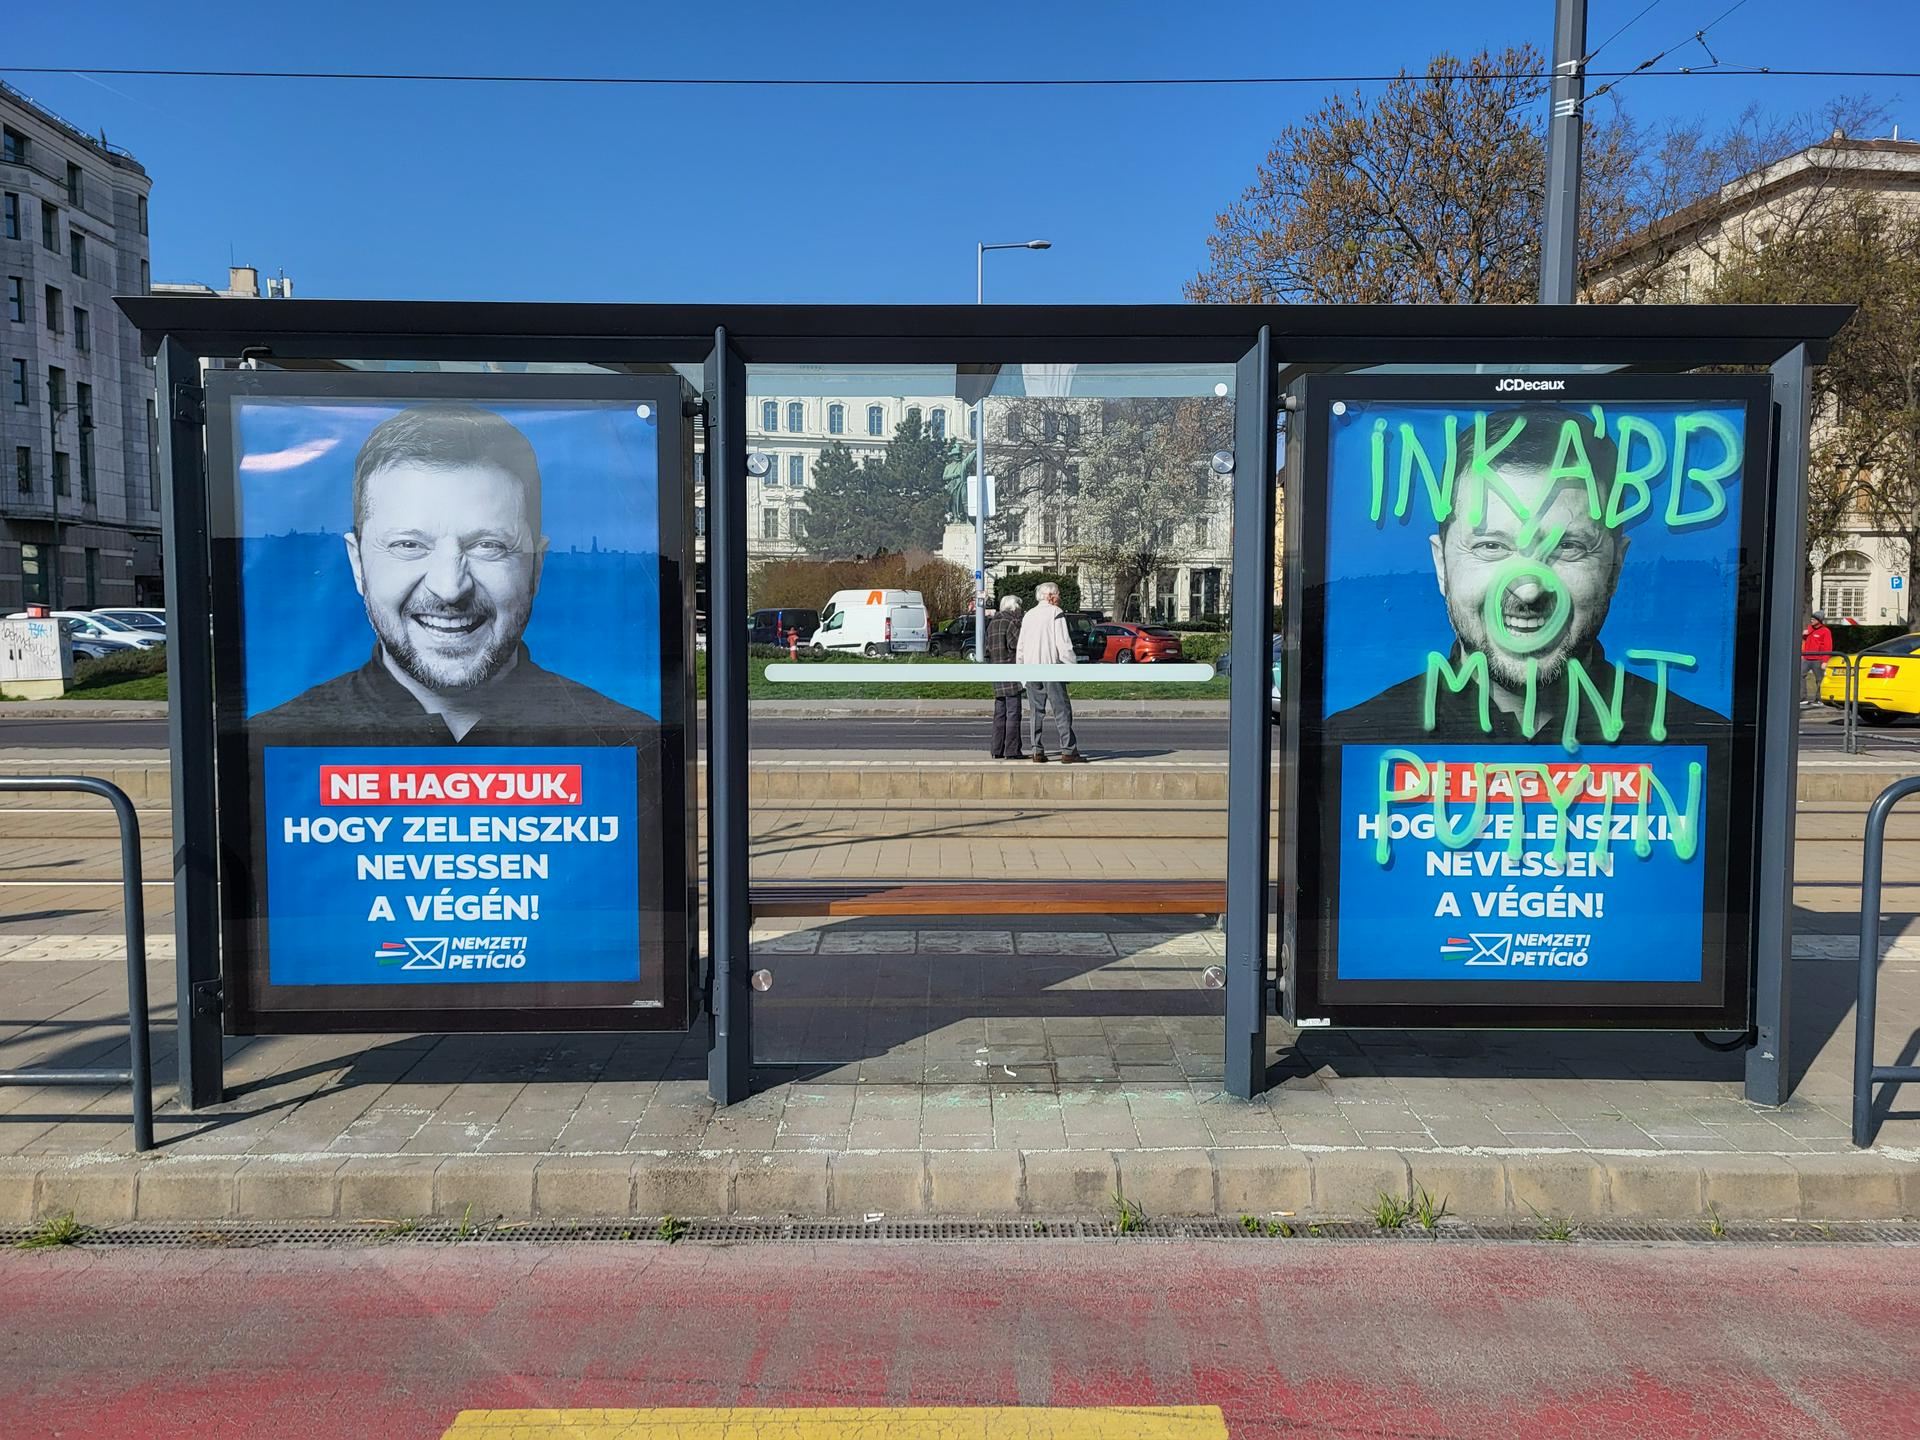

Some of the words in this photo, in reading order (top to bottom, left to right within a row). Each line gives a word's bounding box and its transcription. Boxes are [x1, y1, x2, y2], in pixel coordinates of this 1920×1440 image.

[1495, 378, 1566, 392] JCDecaux
[1424, 648, 1696, 754] MINT
[330, 773, 380, 800] NE
[389, 772, 578, 803] HAGYJUK,
[1461, 771, 1644, 801] HAGYJUK
[1375, 749, 1702, 872] PUTYIN
[283, 816, 393, 843] HOGY
[402, 815, 619, 843] ZELENSZKIJ
[357, 854, 549, 881] NEVESSEN
[1426, 851, 1614, 877] NEVESSEN
[367, 895, 396, 922] A
[405, 887, 540, 922] VÉGÉN!
[1434, 891, 1462, 917] A
[1471, 884, 1604, 919] VÉGÉN!
[451, 936, 528, 950] NEMZETI
[1514, 933, 1591, 947] NEMZETI
[448, 951, 527, 970] PETÍCIÓ
[1511, 948, 1589, 967] PETÍCIÓ
